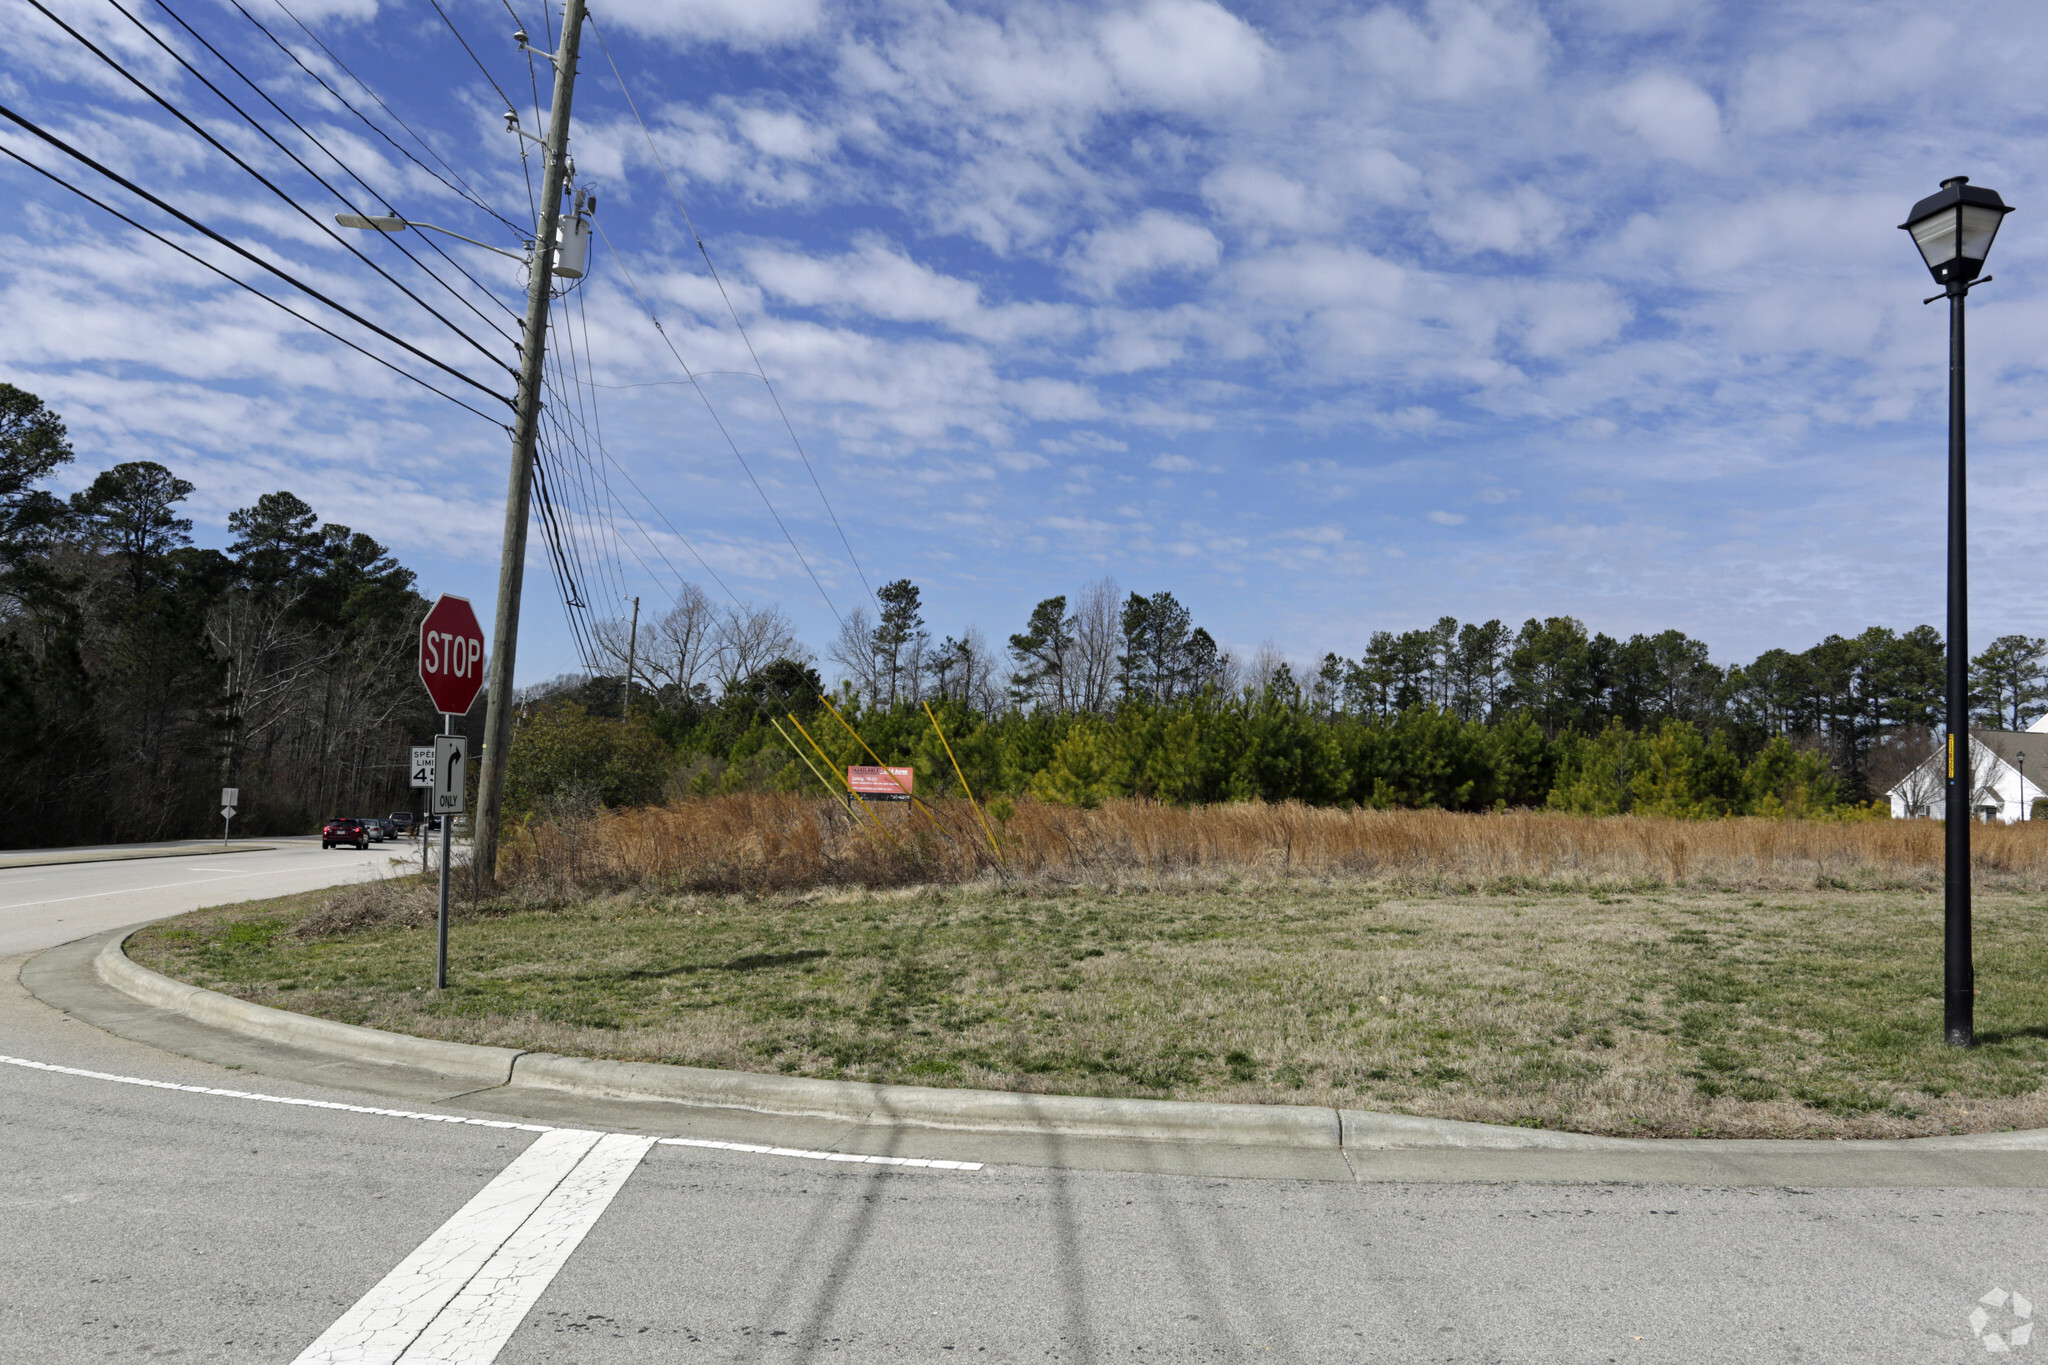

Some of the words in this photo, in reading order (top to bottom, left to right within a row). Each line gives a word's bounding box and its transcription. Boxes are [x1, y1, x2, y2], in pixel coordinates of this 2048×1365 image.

[425, 630, 481, 679] STOP
[416, 759, 434, 767] LIMI
[412, 767, 434, 783] 4
[439, 794, 458, 808] ONLY
